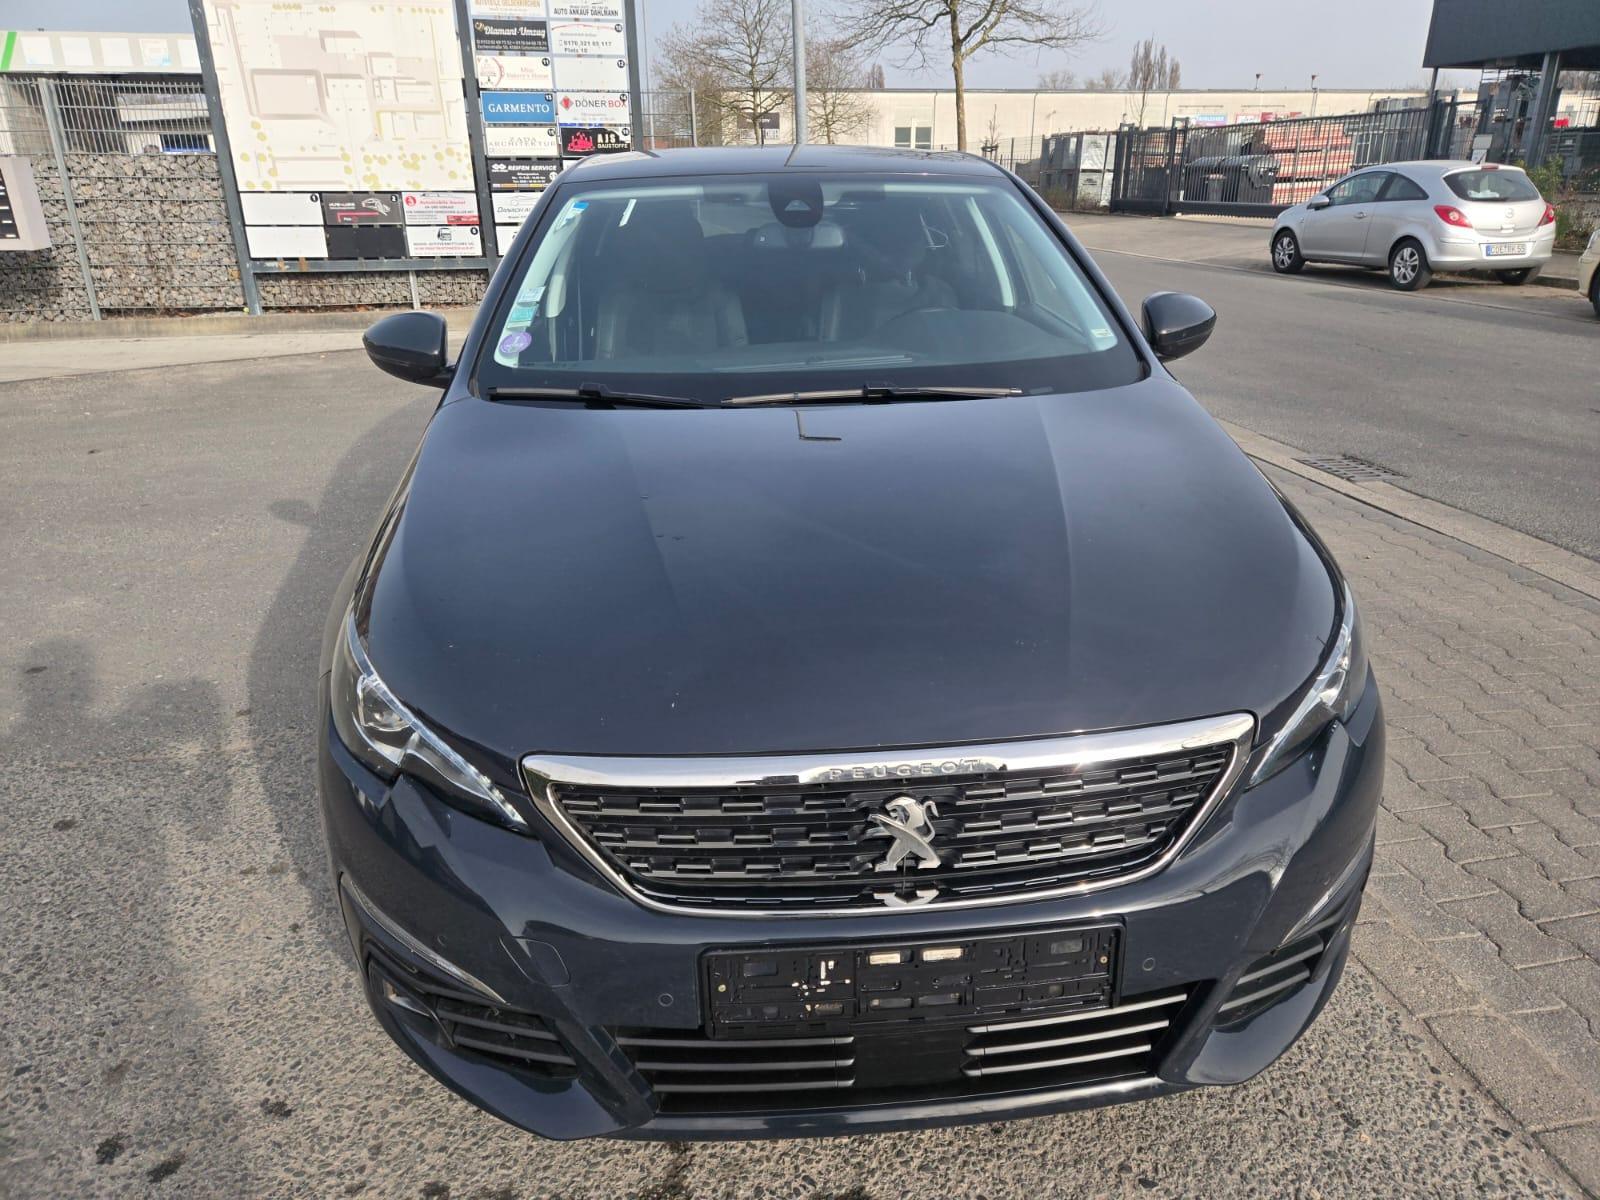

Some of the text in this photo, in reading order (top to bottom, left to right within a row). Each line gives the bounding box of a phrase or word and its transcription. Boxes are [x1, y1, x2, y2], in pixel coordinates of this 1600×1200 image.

[553, 7, 568, 15] AUTO
[569, 8, 589, 16] ANKAUF
[488, 103, 550, 113] GARMENTO
[575, 98, 627, 108] DÖNER BOX
[829, 759, 981, 780] PEUGEOT
